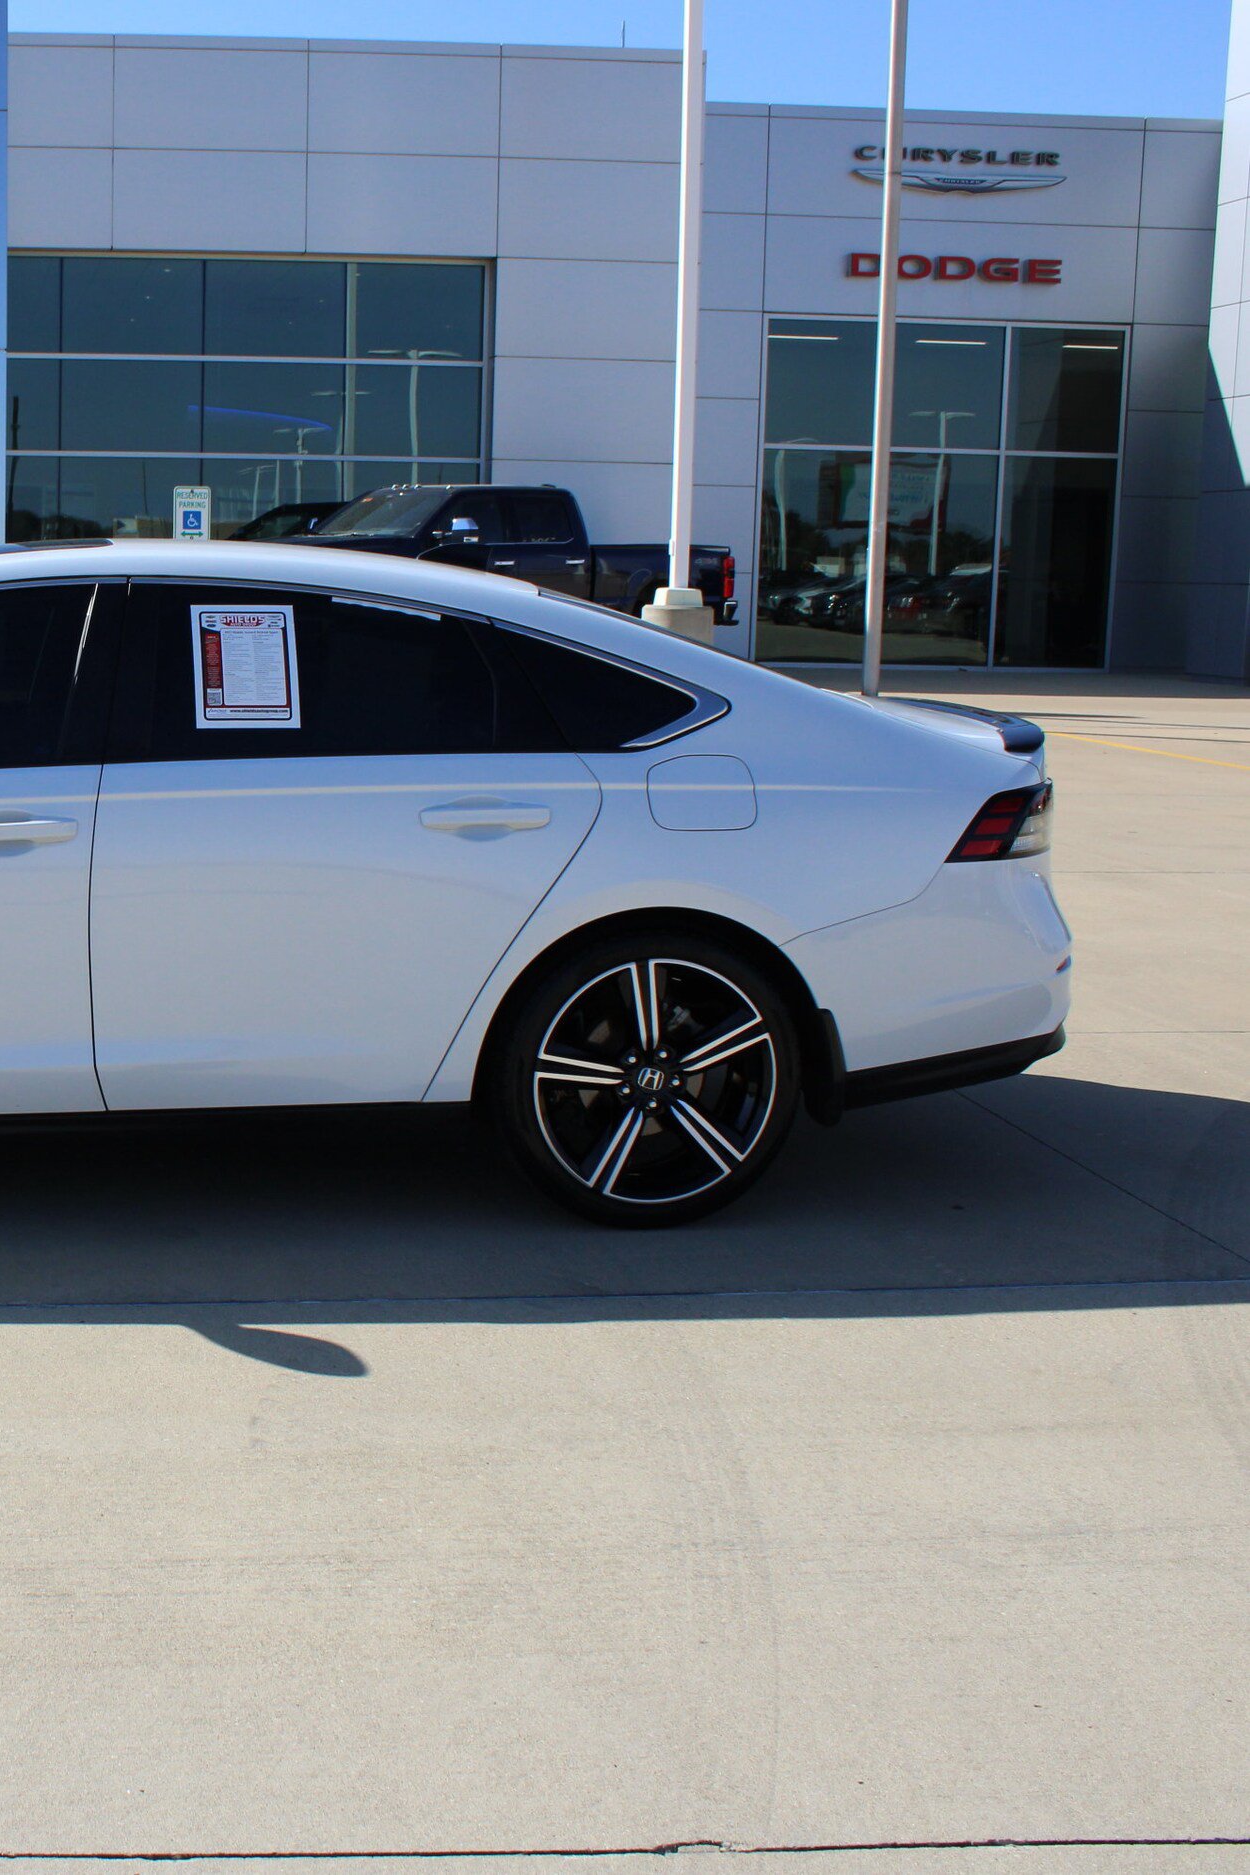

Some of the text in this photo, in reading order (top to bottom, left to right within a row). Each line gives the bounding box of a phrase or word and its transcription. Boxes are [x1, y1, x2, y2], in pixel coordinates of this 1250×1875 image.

[849, 253, 1063, 284] DODGE
[176, 491, 208, 499] RESERVED
[220, 615, 265, 623] SHIELDS
